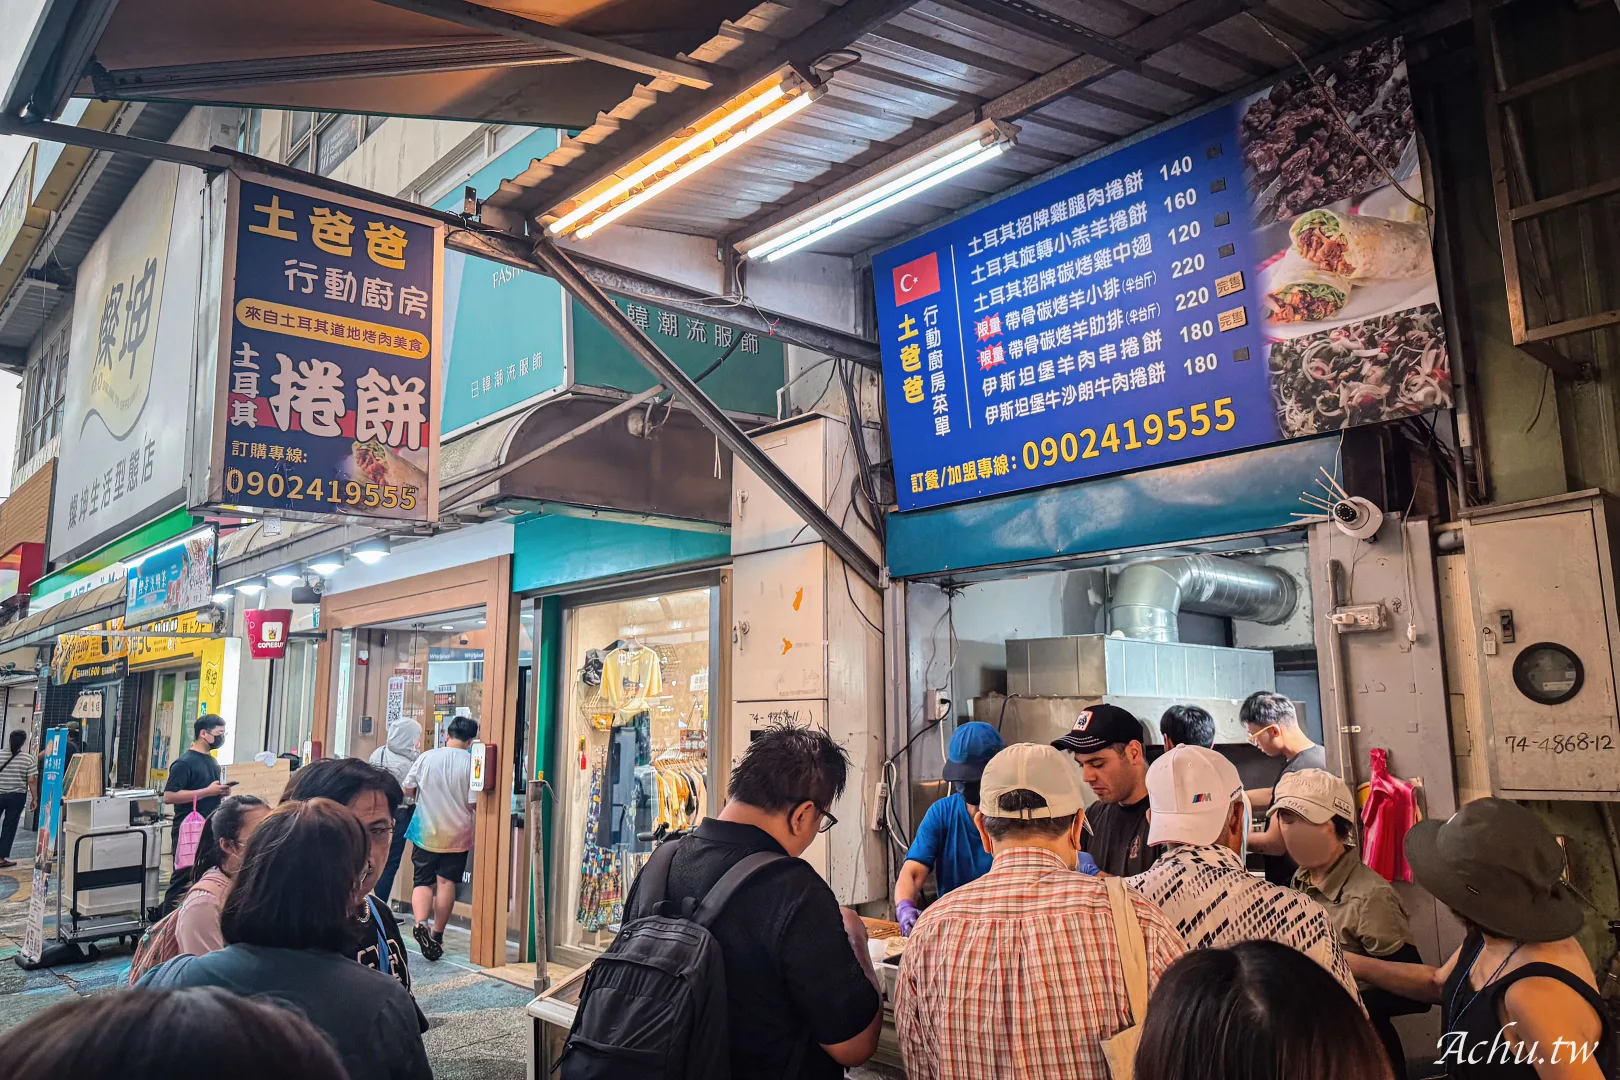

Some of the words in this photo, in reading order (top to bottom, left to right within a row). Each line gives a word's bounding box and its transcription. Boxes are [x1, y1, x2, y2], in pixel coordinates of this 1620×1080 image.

[248, 194, 409, 270] 土爸爸
[967, 168, 1144, 257] 土耳其招牌雞腿肉捲餅
[1159, 155, 1193, 181] 140
[970, 200, 1148, 285] 土耳其旋轉小羔羊捲餅
[1163, 188, 1197, 214] 160
[284, 259, 429, 320] 行動廚房
[973, 232, 1153, 314] 土耳其招牌碳烤雞中翅
[1167, 220, 1201, 246] 120
[977, 316, 1002, 338] 限量
[1171, 253, 1205, 279] 220
[93, 257, 157, 380] 燦坤
[245, 305, 423, 353] 來自土耳其道地烤肉美食
[611, 300, 760, 355] 韓潮流服飾
[979, 345, 1005, 367] 限量
[1175, 286, 1209, 312] 220
[982, 328, 1163, 397] 伊斯坦堡羊肉串捲餅
[1179, 319, 1214, 344] 180
[230, 341, 260, 429] 土耳其
[470, 350, 544, 399] 日韓潮流服飾
[897, 313, 925, 404] 土爸爸
[923, 304, 951, 437] 行動廚房菜單
[985, 360, 1166, 426] 伊斯坦堡牛沙朗牛肉捲餅
[1183, 352, 1218, 376] 180
[268, 352, 427, 451] 捲餅
[1021, 396, 1236, 470] 0902419555
[226, 469, 417, 510] 0902419555
[1504, 731, 1616, 755] 74-4868-12
